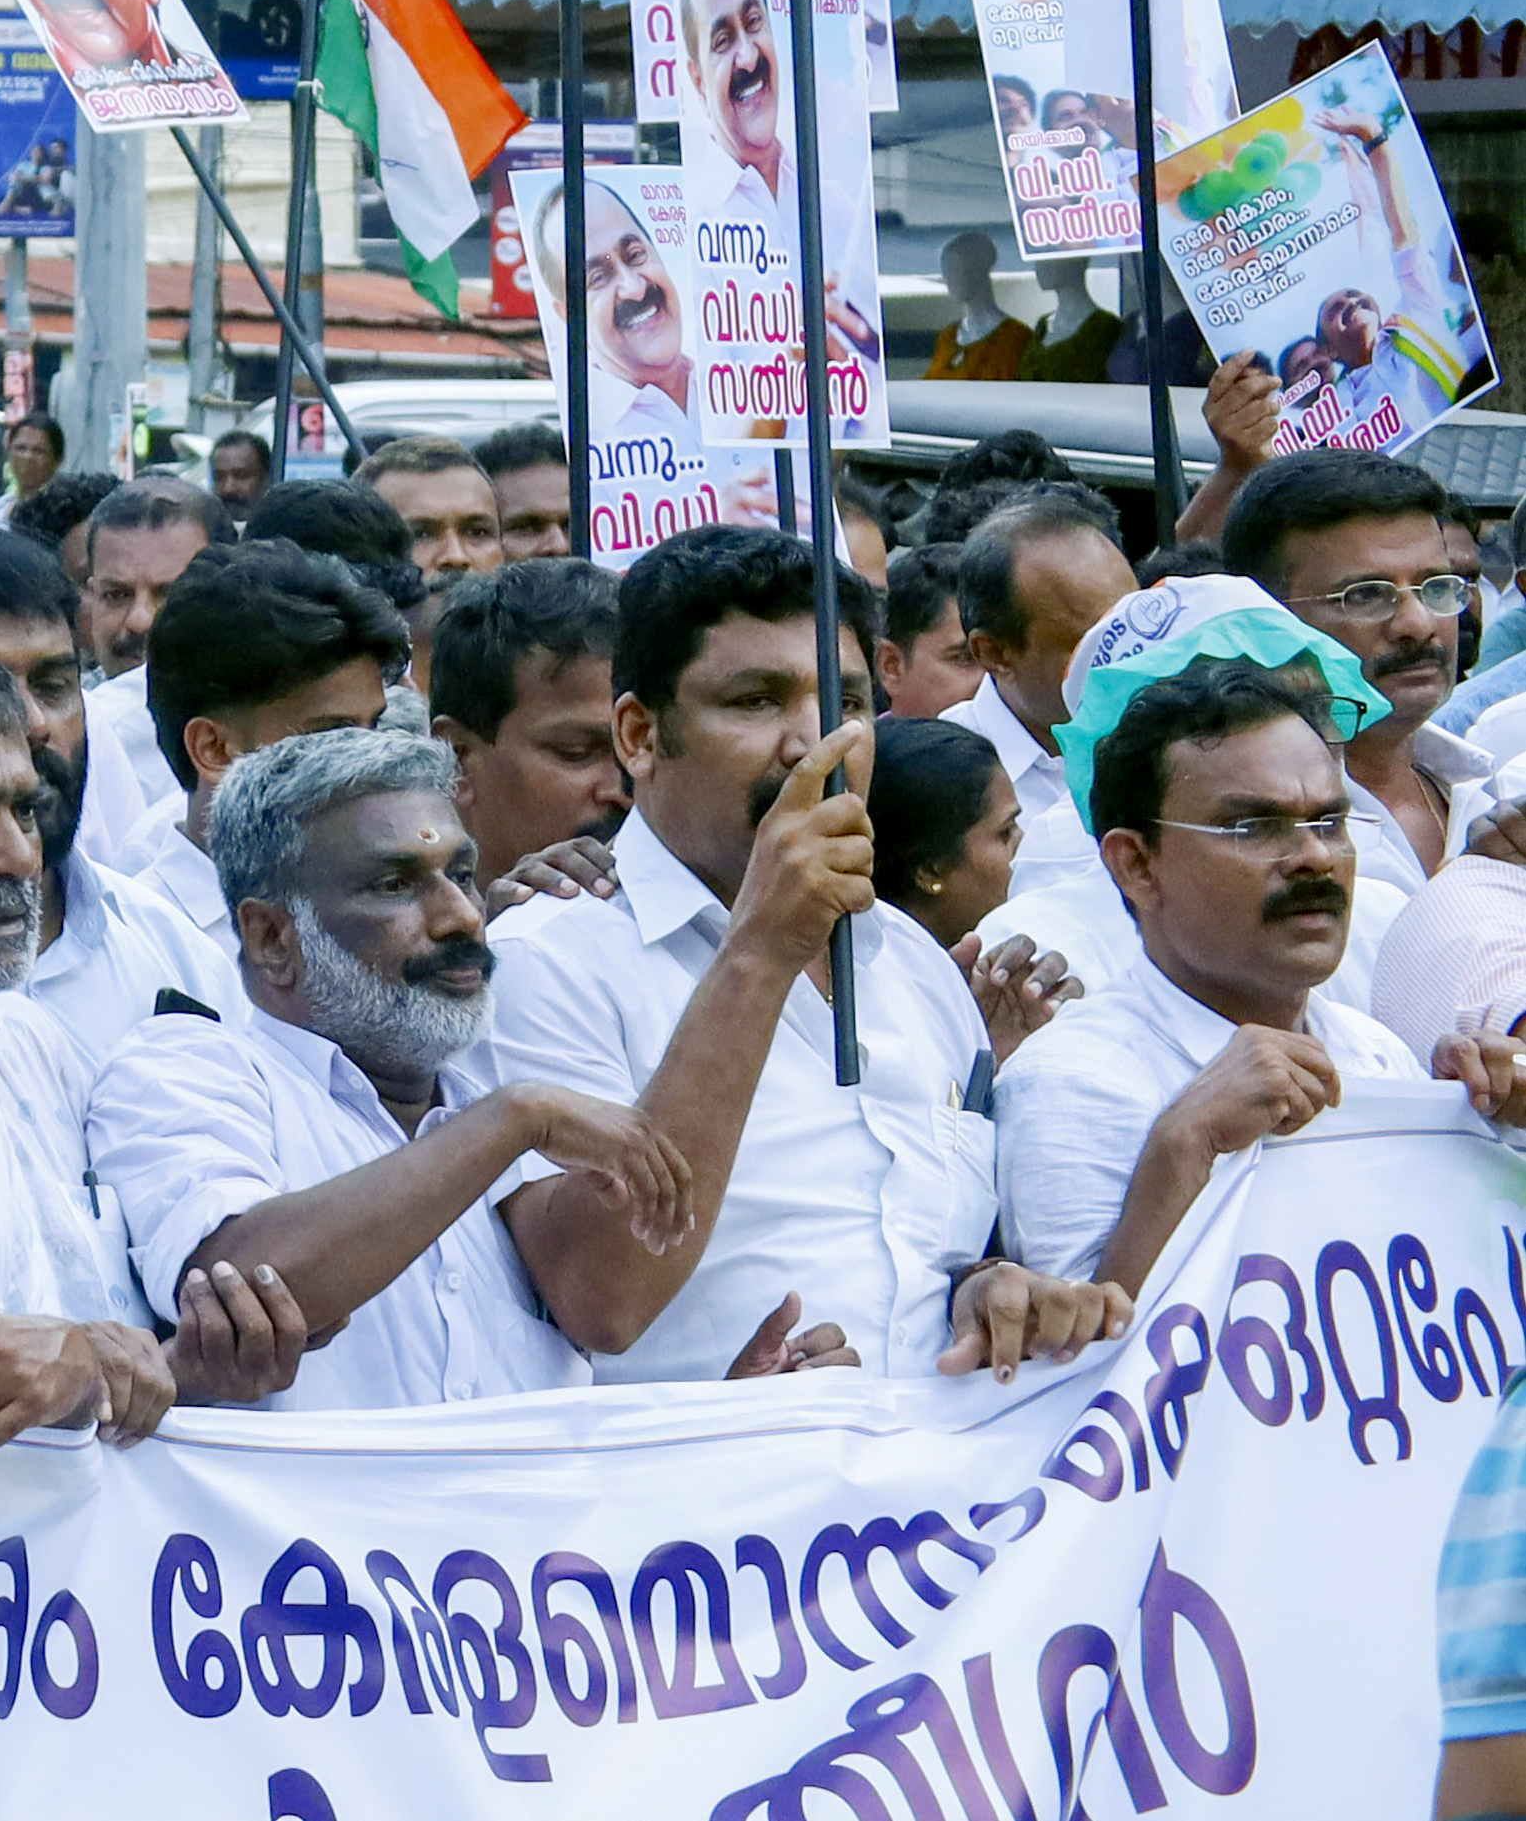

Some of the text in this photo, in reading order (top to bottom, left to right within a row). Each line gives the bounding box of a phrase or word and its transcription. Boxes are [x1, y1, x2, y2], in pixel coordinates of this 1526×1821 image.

[1015, 151, 1113, 199] വി.ഡി.
[1025, 196, 1142, 245] സതീശ
[698, 222, 788, 274] വന്നു...
